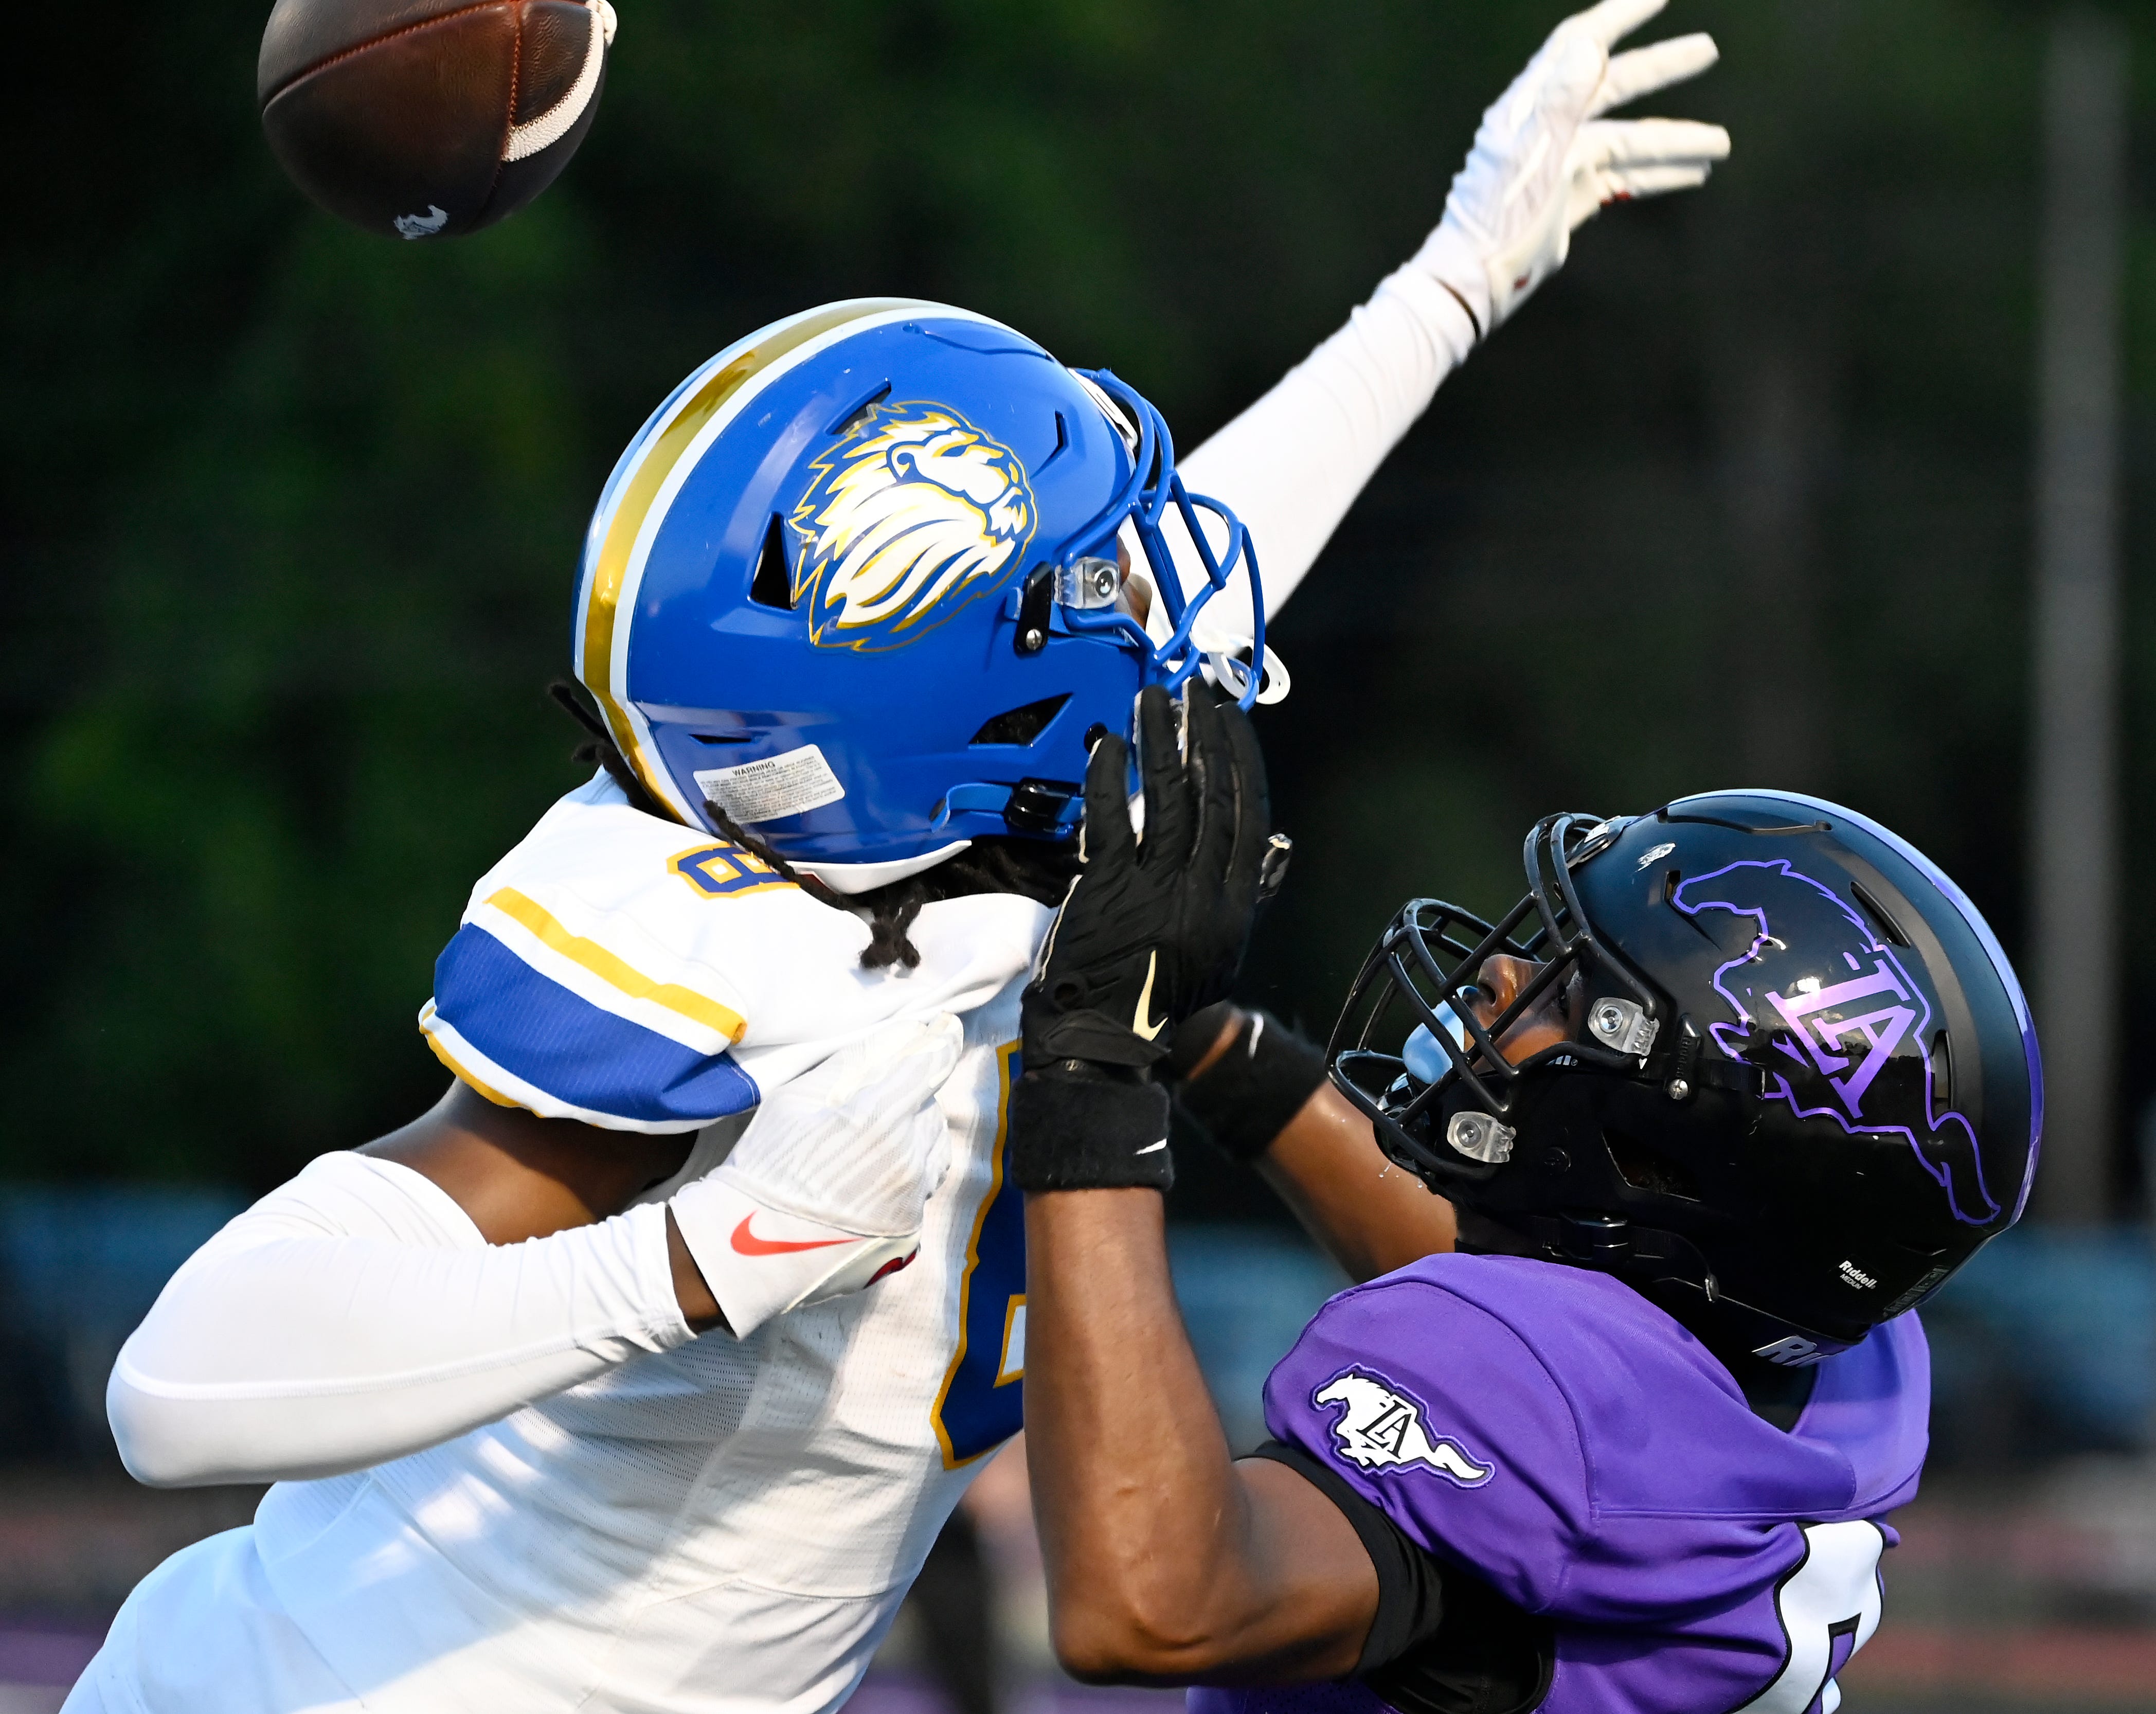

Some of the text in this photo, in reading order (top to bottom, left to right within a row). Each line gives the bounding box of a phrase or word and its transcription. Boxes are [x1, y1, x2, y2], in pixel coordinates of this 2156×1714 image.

[732, 761, 775, 776] WARNING
[1765, 959, 1916, 1118] LA
[1839, 1260, 1877, 1288] Riddell
[1840, 1273, 1863, 1290] MEDIUM
[1356, 1400, 1412, 1459] LA
